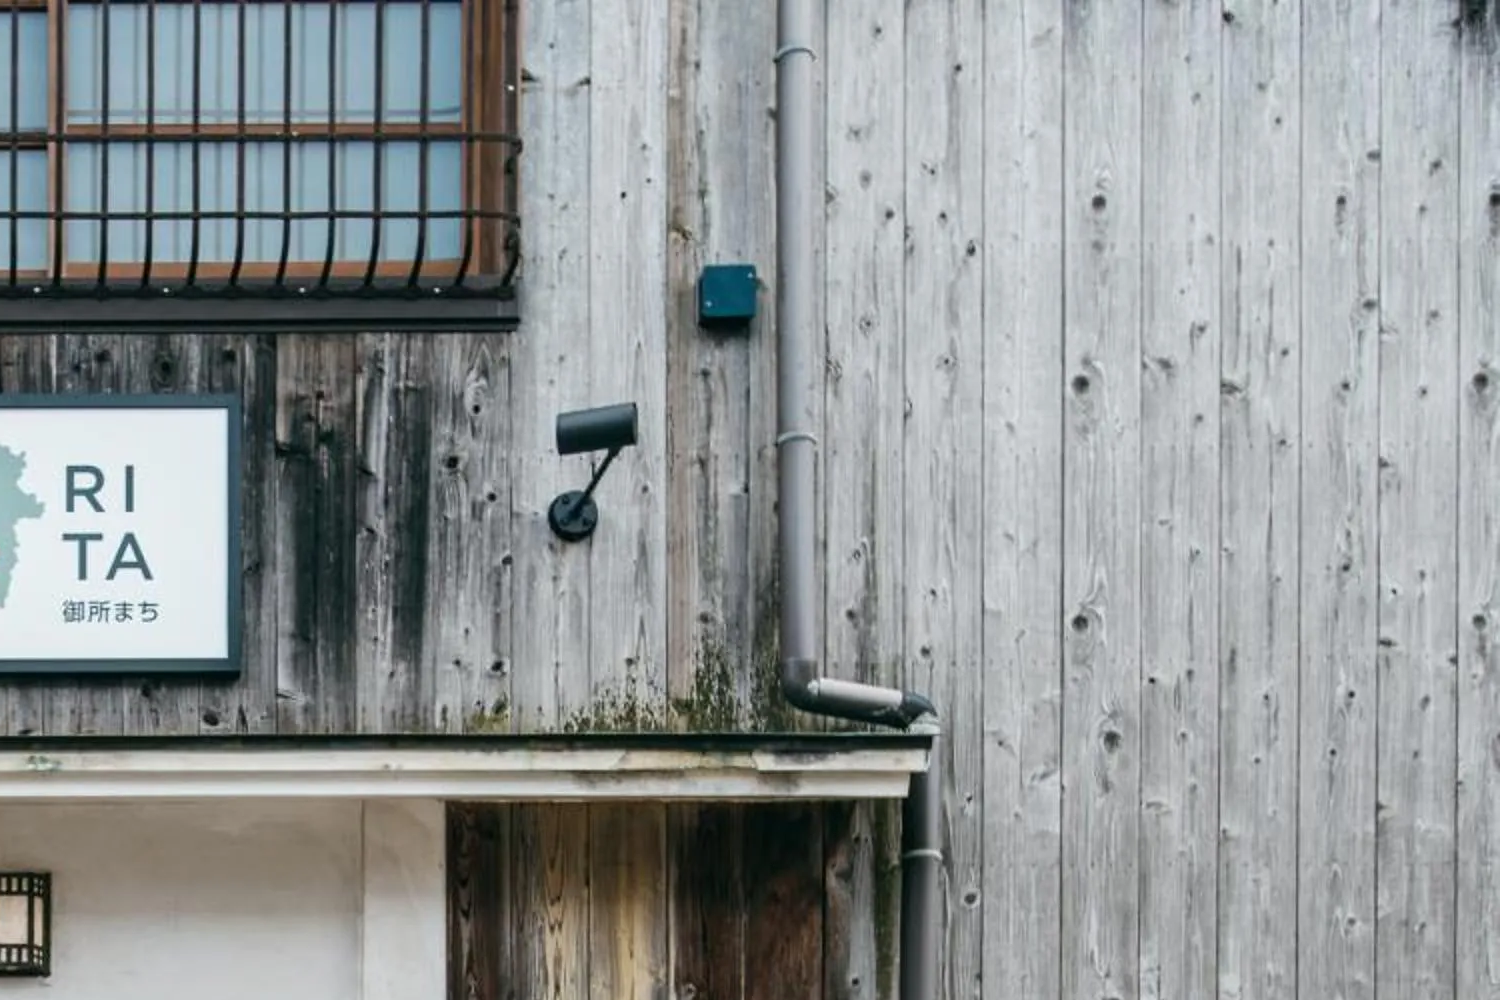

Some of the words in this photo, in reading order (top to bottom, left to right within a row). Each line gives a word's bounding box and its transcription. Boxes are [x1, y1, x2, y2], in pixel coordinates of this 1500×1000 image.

[65, 464, 135, 513] RI
[62, 532, 154, 581] TA
[62, 600, 159, 624] 御所まち
